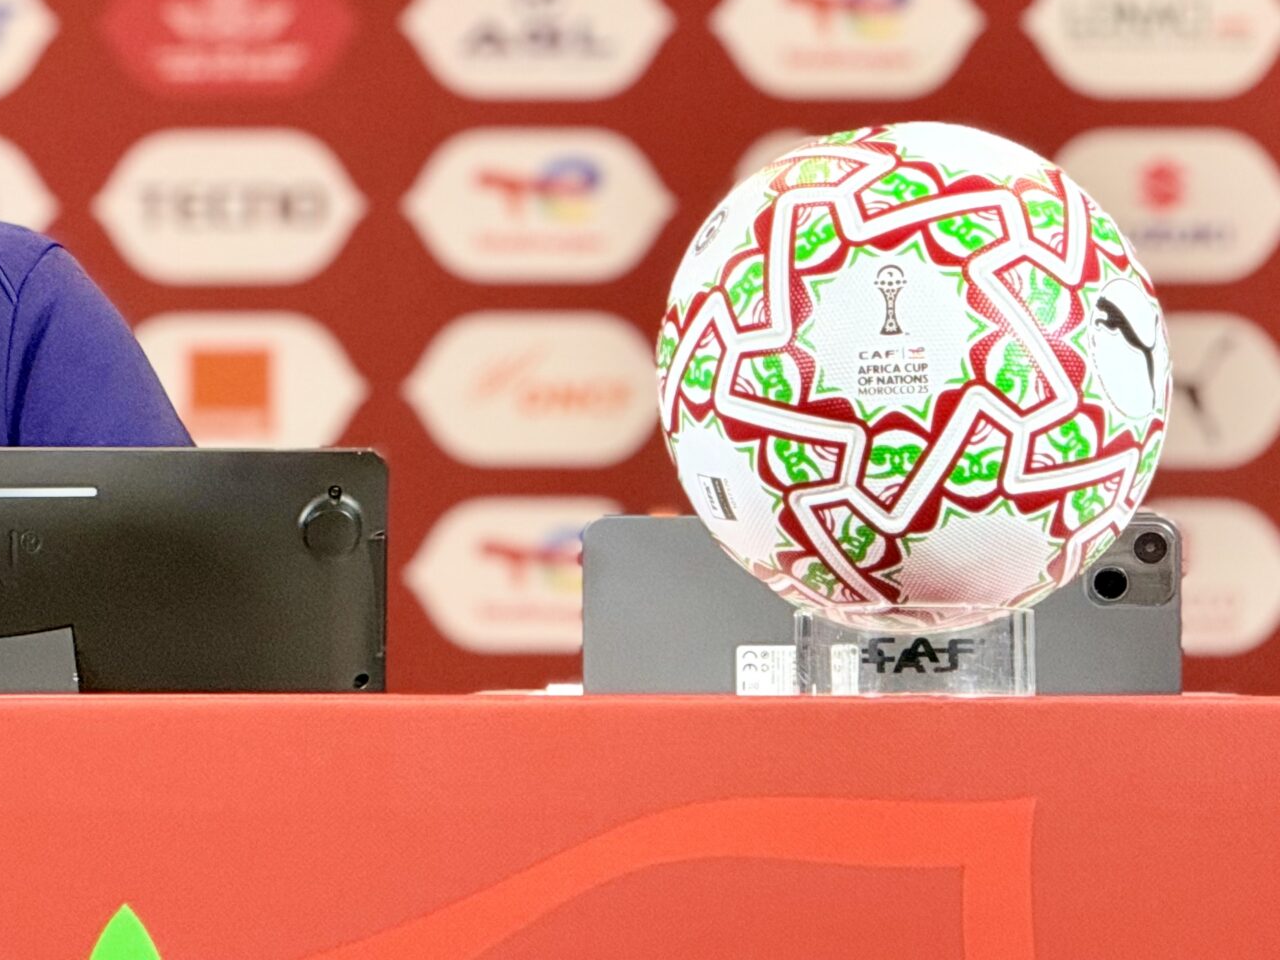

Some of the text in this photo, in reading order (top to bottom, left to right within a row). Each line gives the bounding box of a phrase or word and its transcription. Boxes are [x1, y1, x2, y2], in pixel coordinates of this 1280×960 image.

[859, 349, 895, 360] CAF
[858, 362, 929, 375] AFRICA CUP
[858, 374, 929, 387] OF NATIONS
[858, 385, 929, 396] MOROCCO 25
